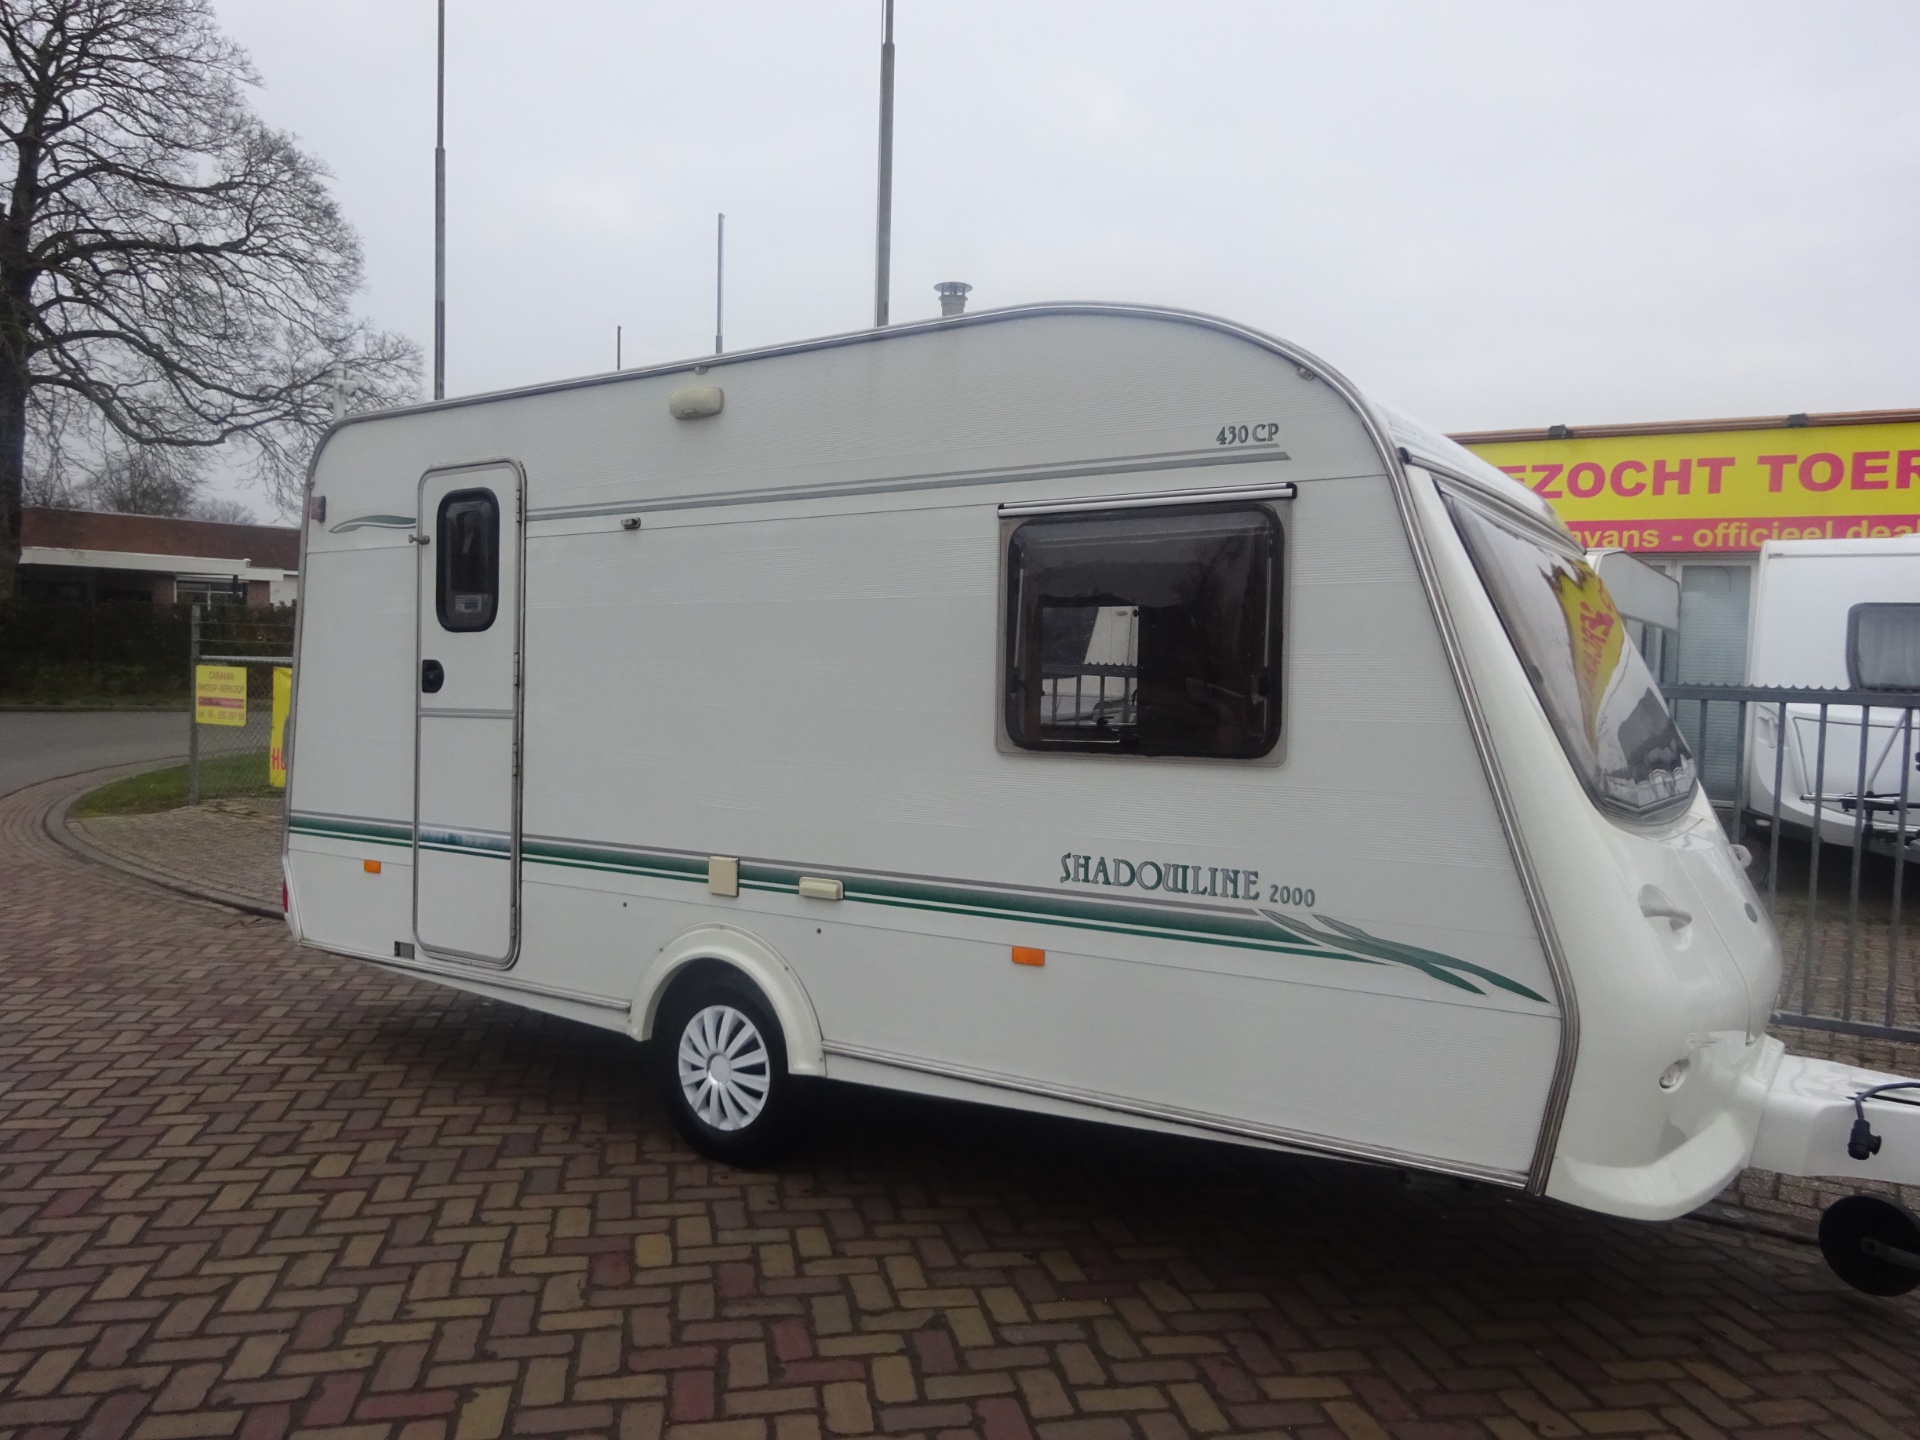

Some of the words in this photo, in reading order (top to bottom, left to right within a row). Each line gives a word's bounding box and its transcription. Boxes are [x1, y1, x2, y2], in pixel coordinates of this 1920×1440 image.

[1216, 425, 1249, 445] 430
[1252, 423, 1279, 442] CP
[1692, 521, 1833, 548] officieel
[1060, 852, 1260, 901] SHADOWLINE
[1269, 884, 1315, 907] 2000
